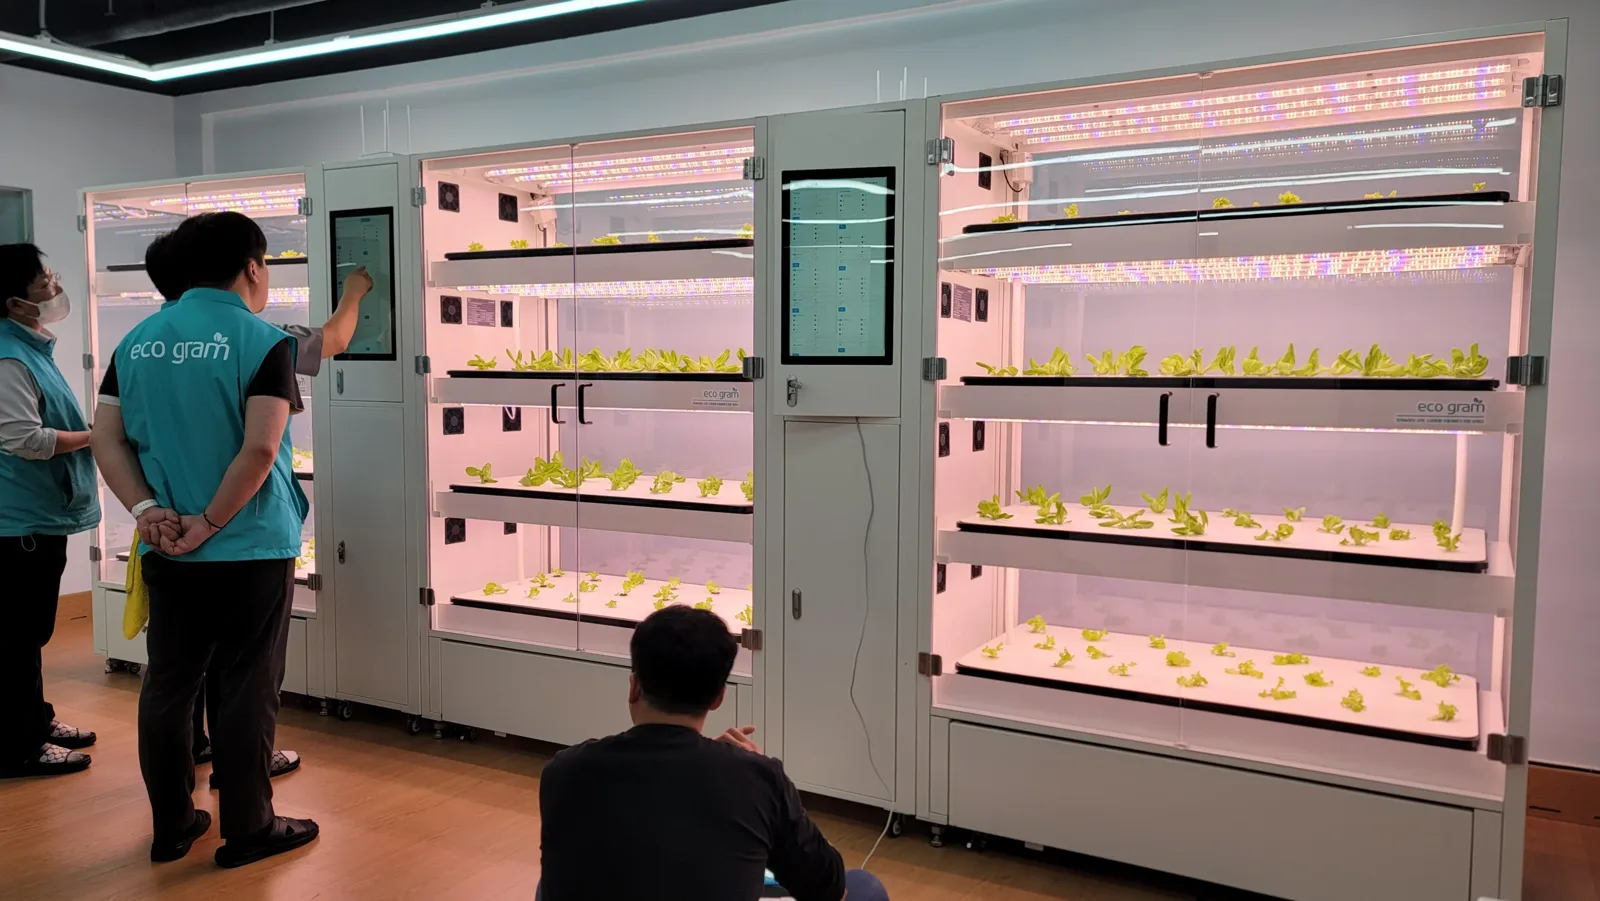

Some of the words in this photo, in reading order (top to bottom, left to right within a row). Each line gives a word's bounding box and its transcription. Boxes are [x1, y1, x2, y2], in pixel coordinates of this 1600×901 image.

[130, 341, 166, 360] eco
[172, 340, 230, 364] gram
[703, 390, 718, 398] eco
[719, 390, 739, 400] gram
[1417, 402, 1443, 412] eco
[1447, 402, 1485, 415] gram
